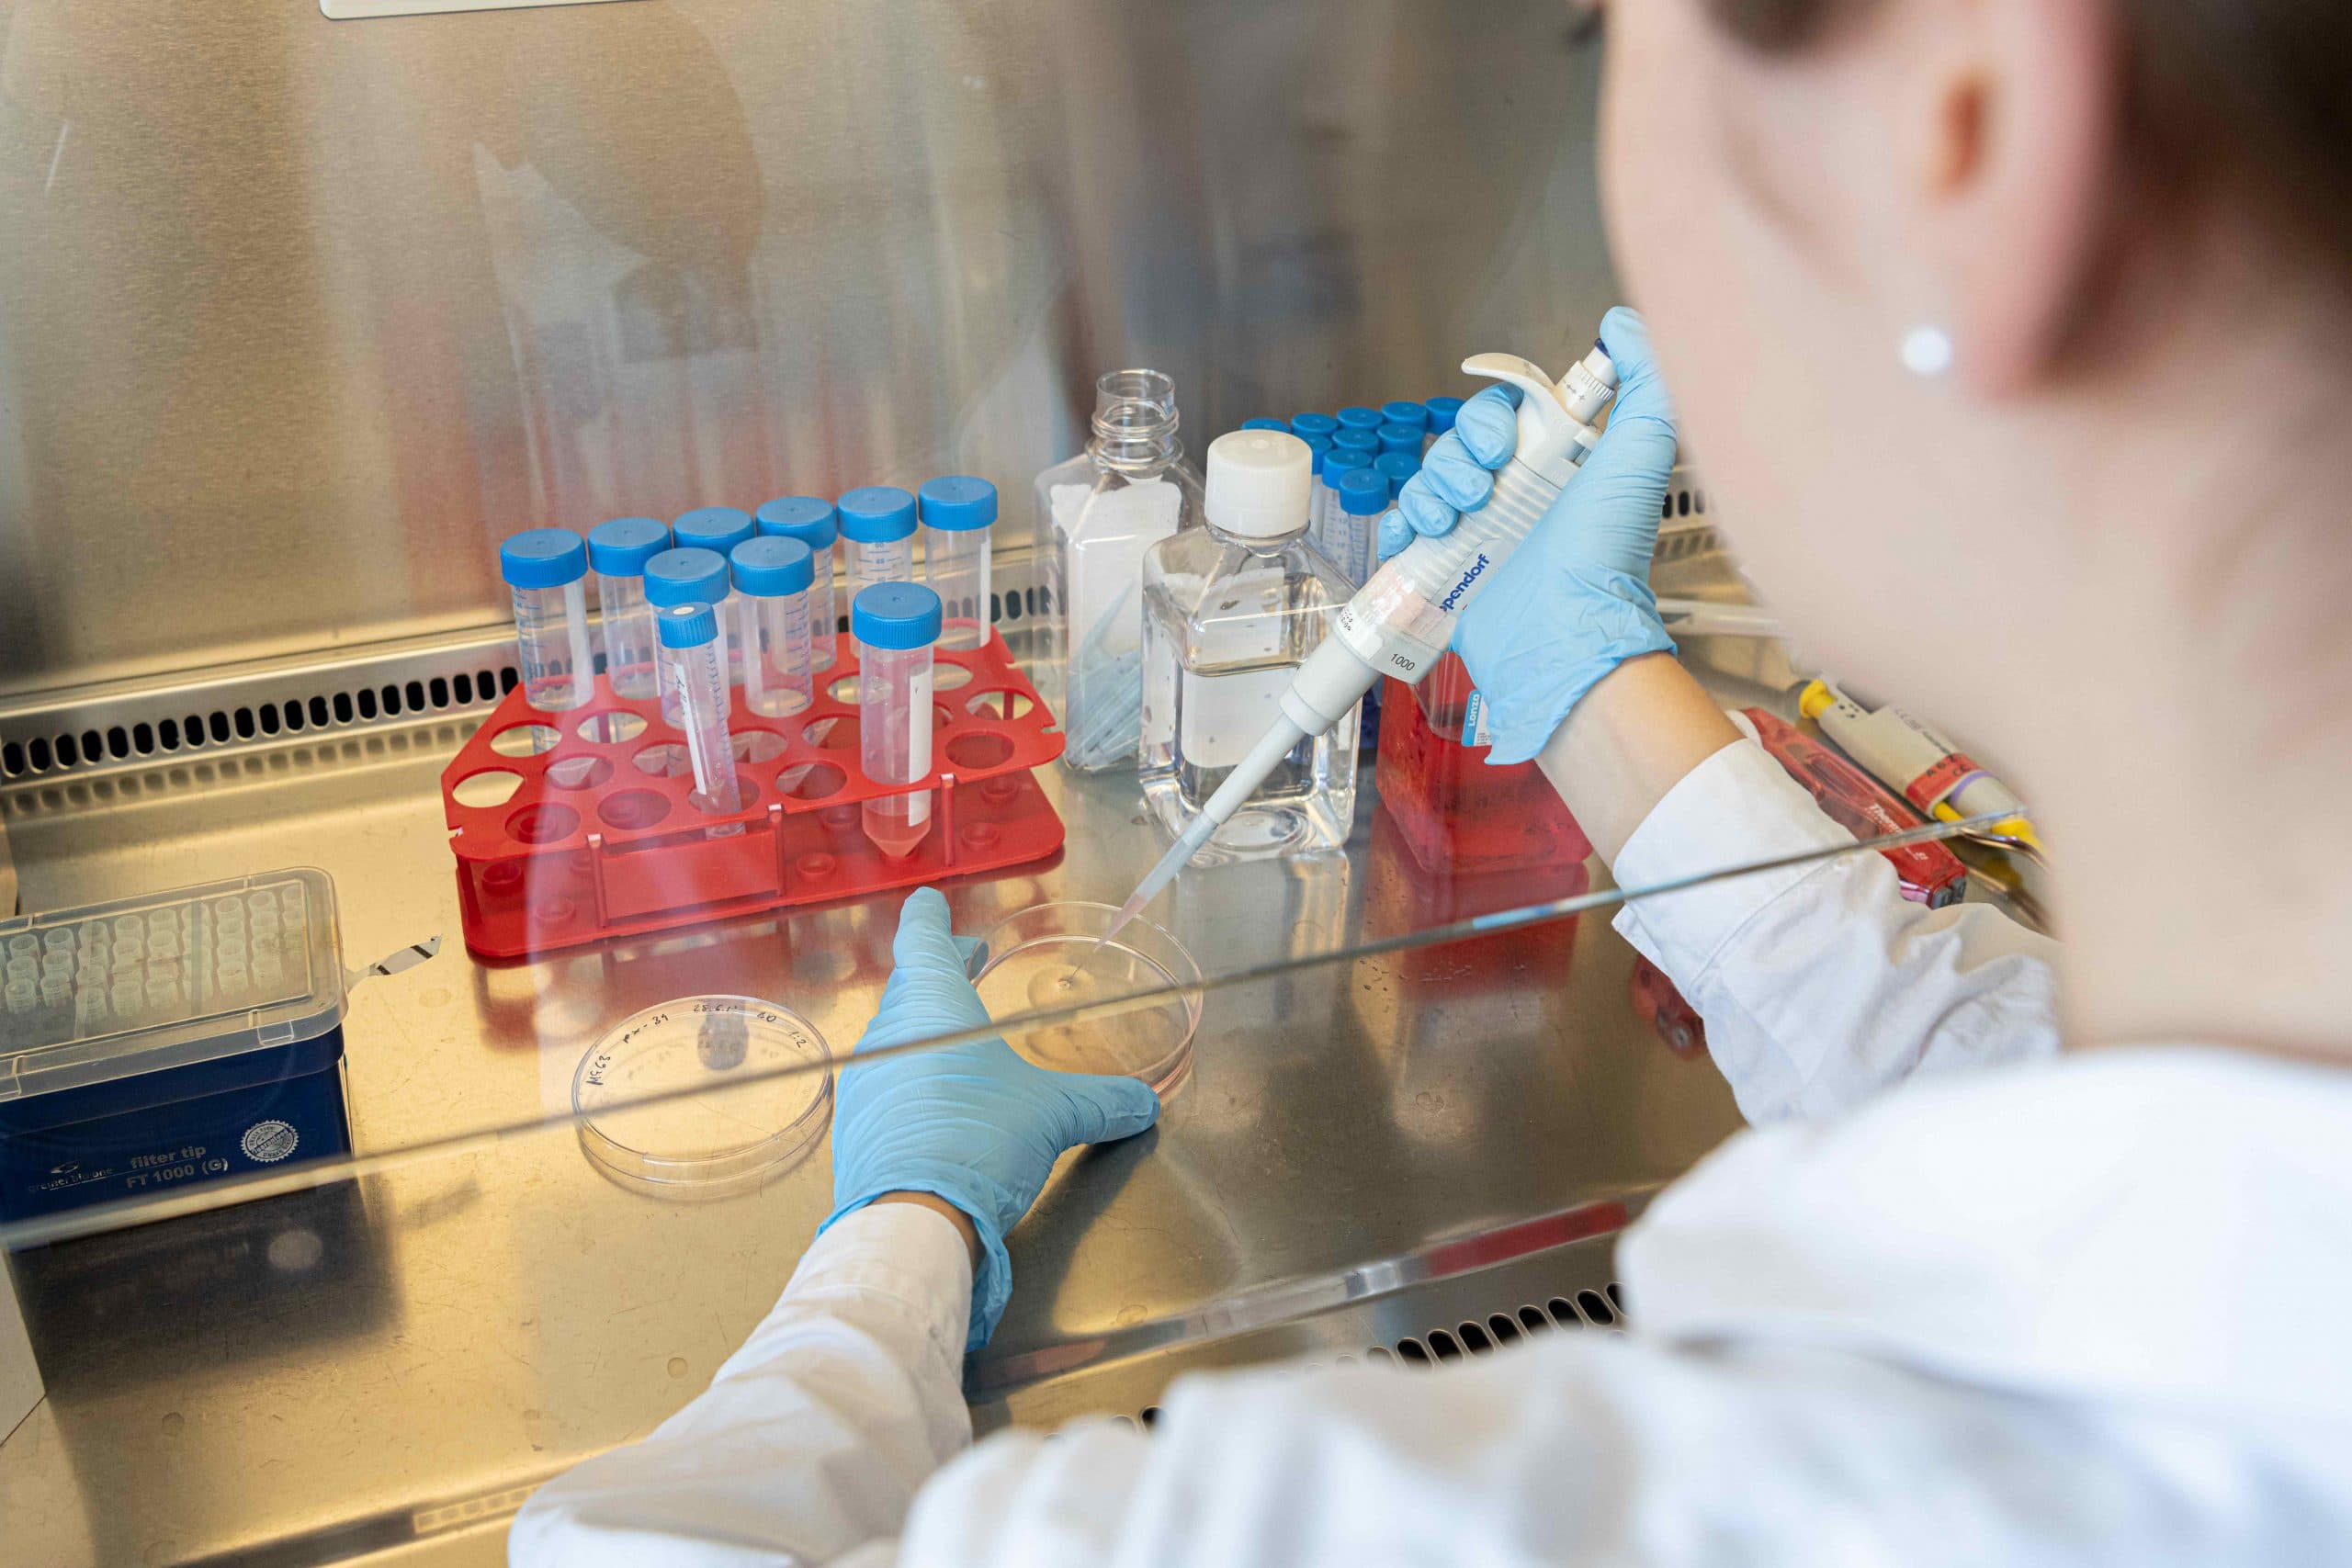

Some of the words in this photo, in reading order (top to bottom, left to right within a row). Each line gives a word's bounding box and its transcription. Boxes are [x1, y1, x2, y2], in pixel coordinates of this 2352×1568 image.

[1389, 652, 1416, 671] 1000
[130, 1151, 177, 1169] filter
[180, 1145, 207, 1160] tip
[125, 1173, 149, 1189] FT
[152, 1164, 196, 1183] 1000
[200, 1157, 230, 1176] (G)
